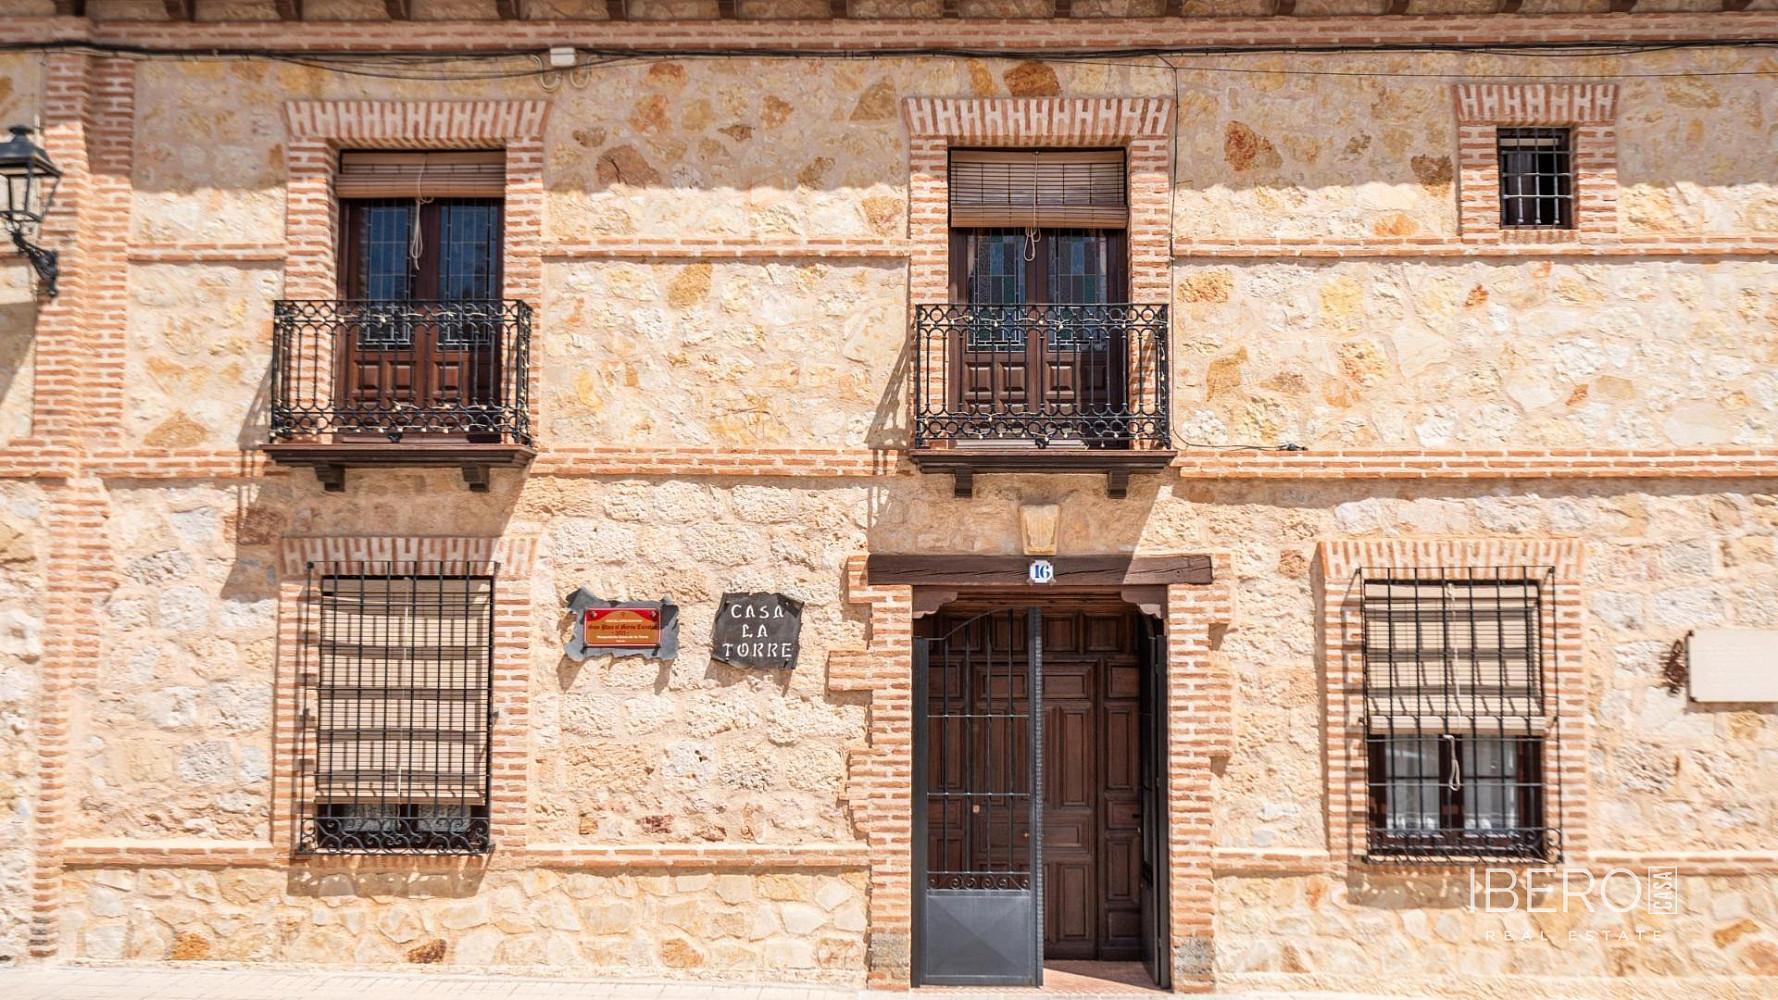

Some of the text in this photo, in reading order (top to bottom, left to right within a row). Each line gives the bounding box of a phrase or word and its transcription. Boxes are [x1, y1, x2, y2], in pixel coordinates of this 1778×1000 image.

[1035, 565, 1050, 578] 16
[731, 604, 784, 619] CASA
[742, 624, 768, 638] LA
[722, 643, 792, 657] TORRE
